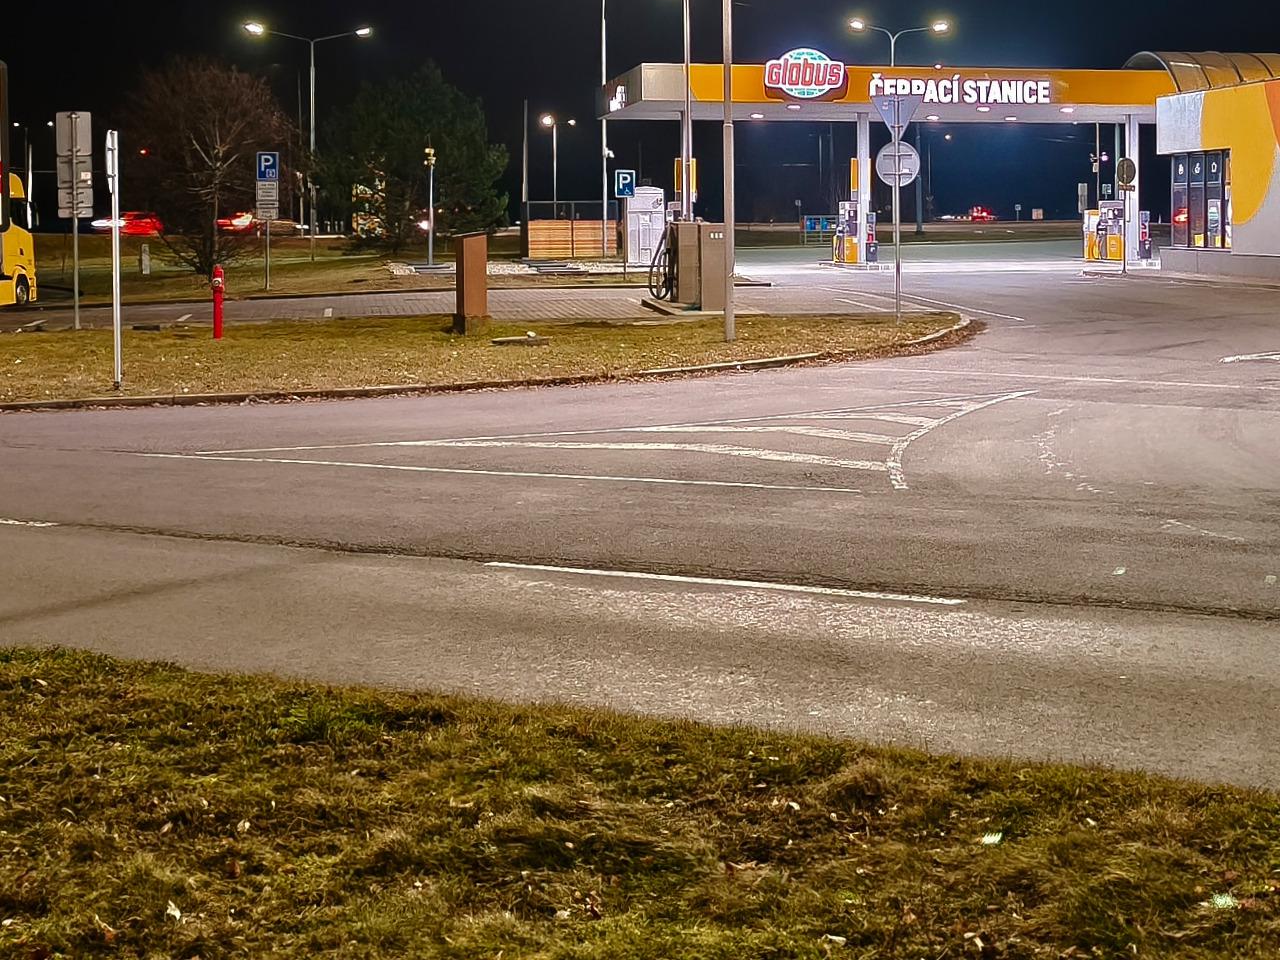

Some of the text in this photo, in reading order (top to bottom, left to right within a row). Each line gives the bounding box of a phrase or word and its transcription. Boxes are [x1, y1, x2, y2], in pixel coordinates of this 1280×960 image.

[768, 58, 841, 86] Globus
[963, 80, 1050, 104] STANICE
[261, 155, 273, 171] P
[619, 174, 630, 189] P
